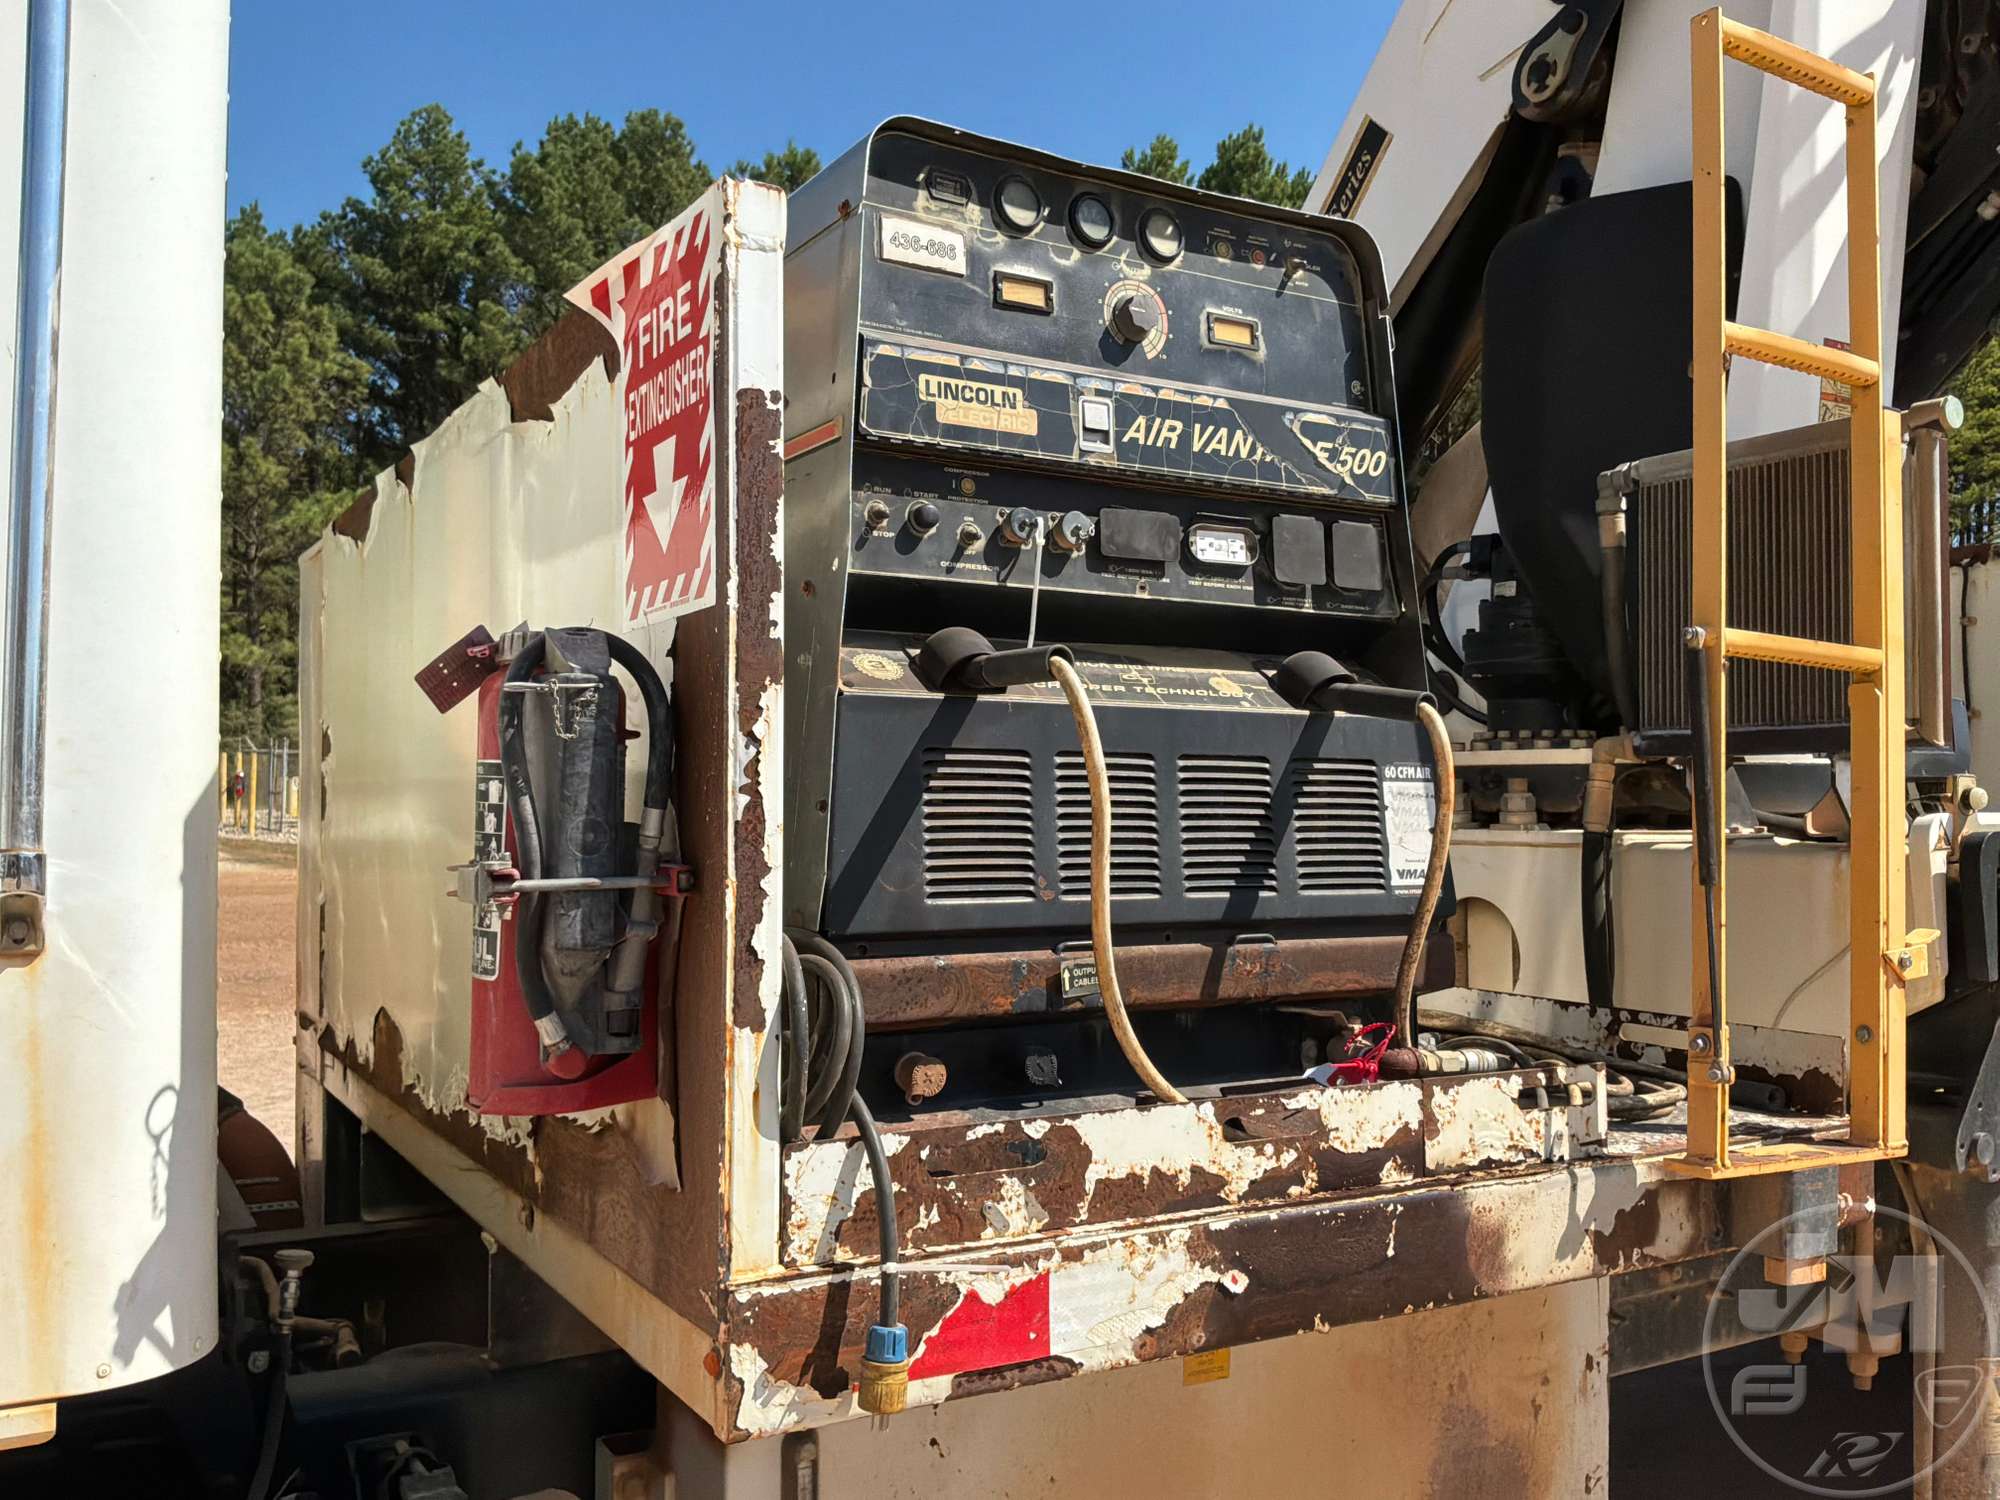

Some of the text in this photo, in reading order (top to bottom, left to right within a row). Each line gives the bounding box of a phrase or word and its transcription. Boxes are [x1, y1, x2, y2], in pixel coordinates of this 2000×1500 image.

[888, 231, 957, 261] 436-686
[637, 282, 694, 369] FIRE
[628, 344, 706, 442] EXTINGUISHER
[924, 378, 1018, 409] LINCOLN
[948, 410, 1032, 434] ELECTRIC
[1121, 415, 1184, 450] AIR
[1337, 446, 1387, 477] 500
[944, 466, 990, 477] COMPRESSOR
[873, 486, 892, 494] RUN
[913, 491, 939, 499] START
[872, 529, 895, 538] STOP
[1132, 686, 1254, 699] TECHNOLOGY
[1384, 766, 1431, 779] 60 CFM AIR
[1396, 868, 1426, 881] VMA
[1073, 967, 1097, 977] OUTPU
